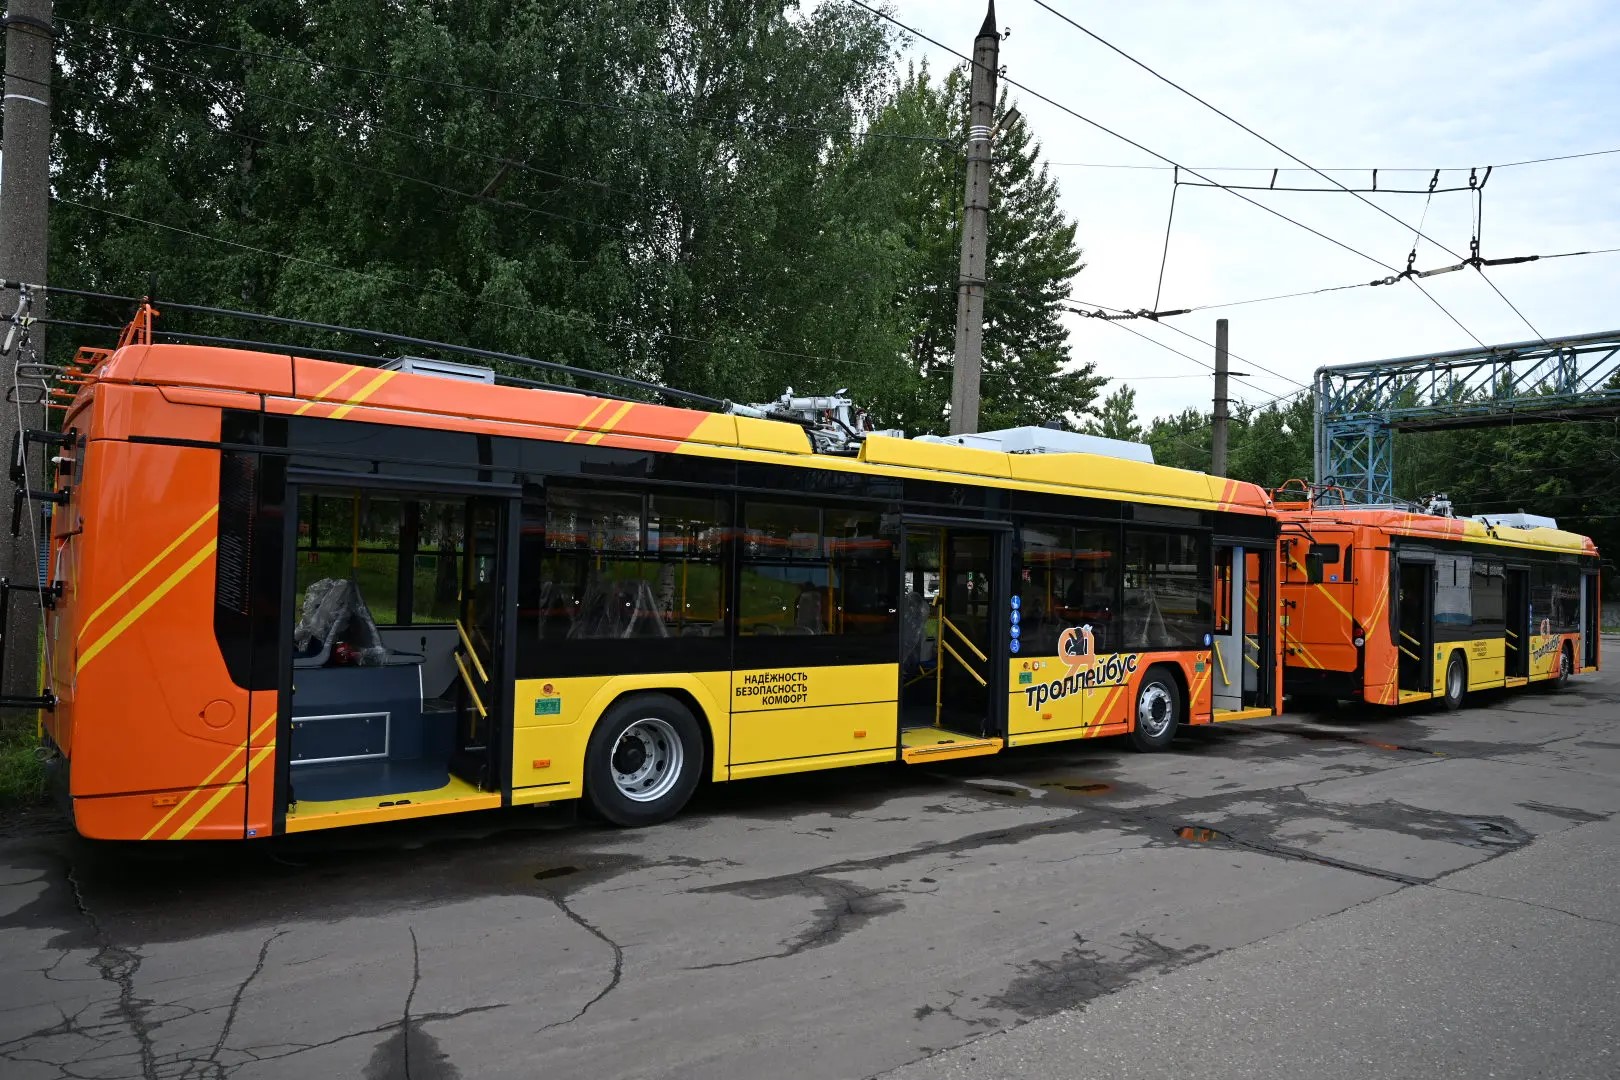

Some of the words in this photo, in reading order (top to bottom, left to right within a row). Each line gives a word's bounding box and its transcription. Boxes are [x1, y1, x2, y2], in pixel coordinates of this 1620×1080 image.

[744, 672, 808, 685] НАДЁЖНОСТЬ
[1025, 652, 1137, 712] троллейбус
[736, 684, 808, 697] БЕЗОПАСНОСТЬ
[762, 694, 808, 705] КОМФОРТ
